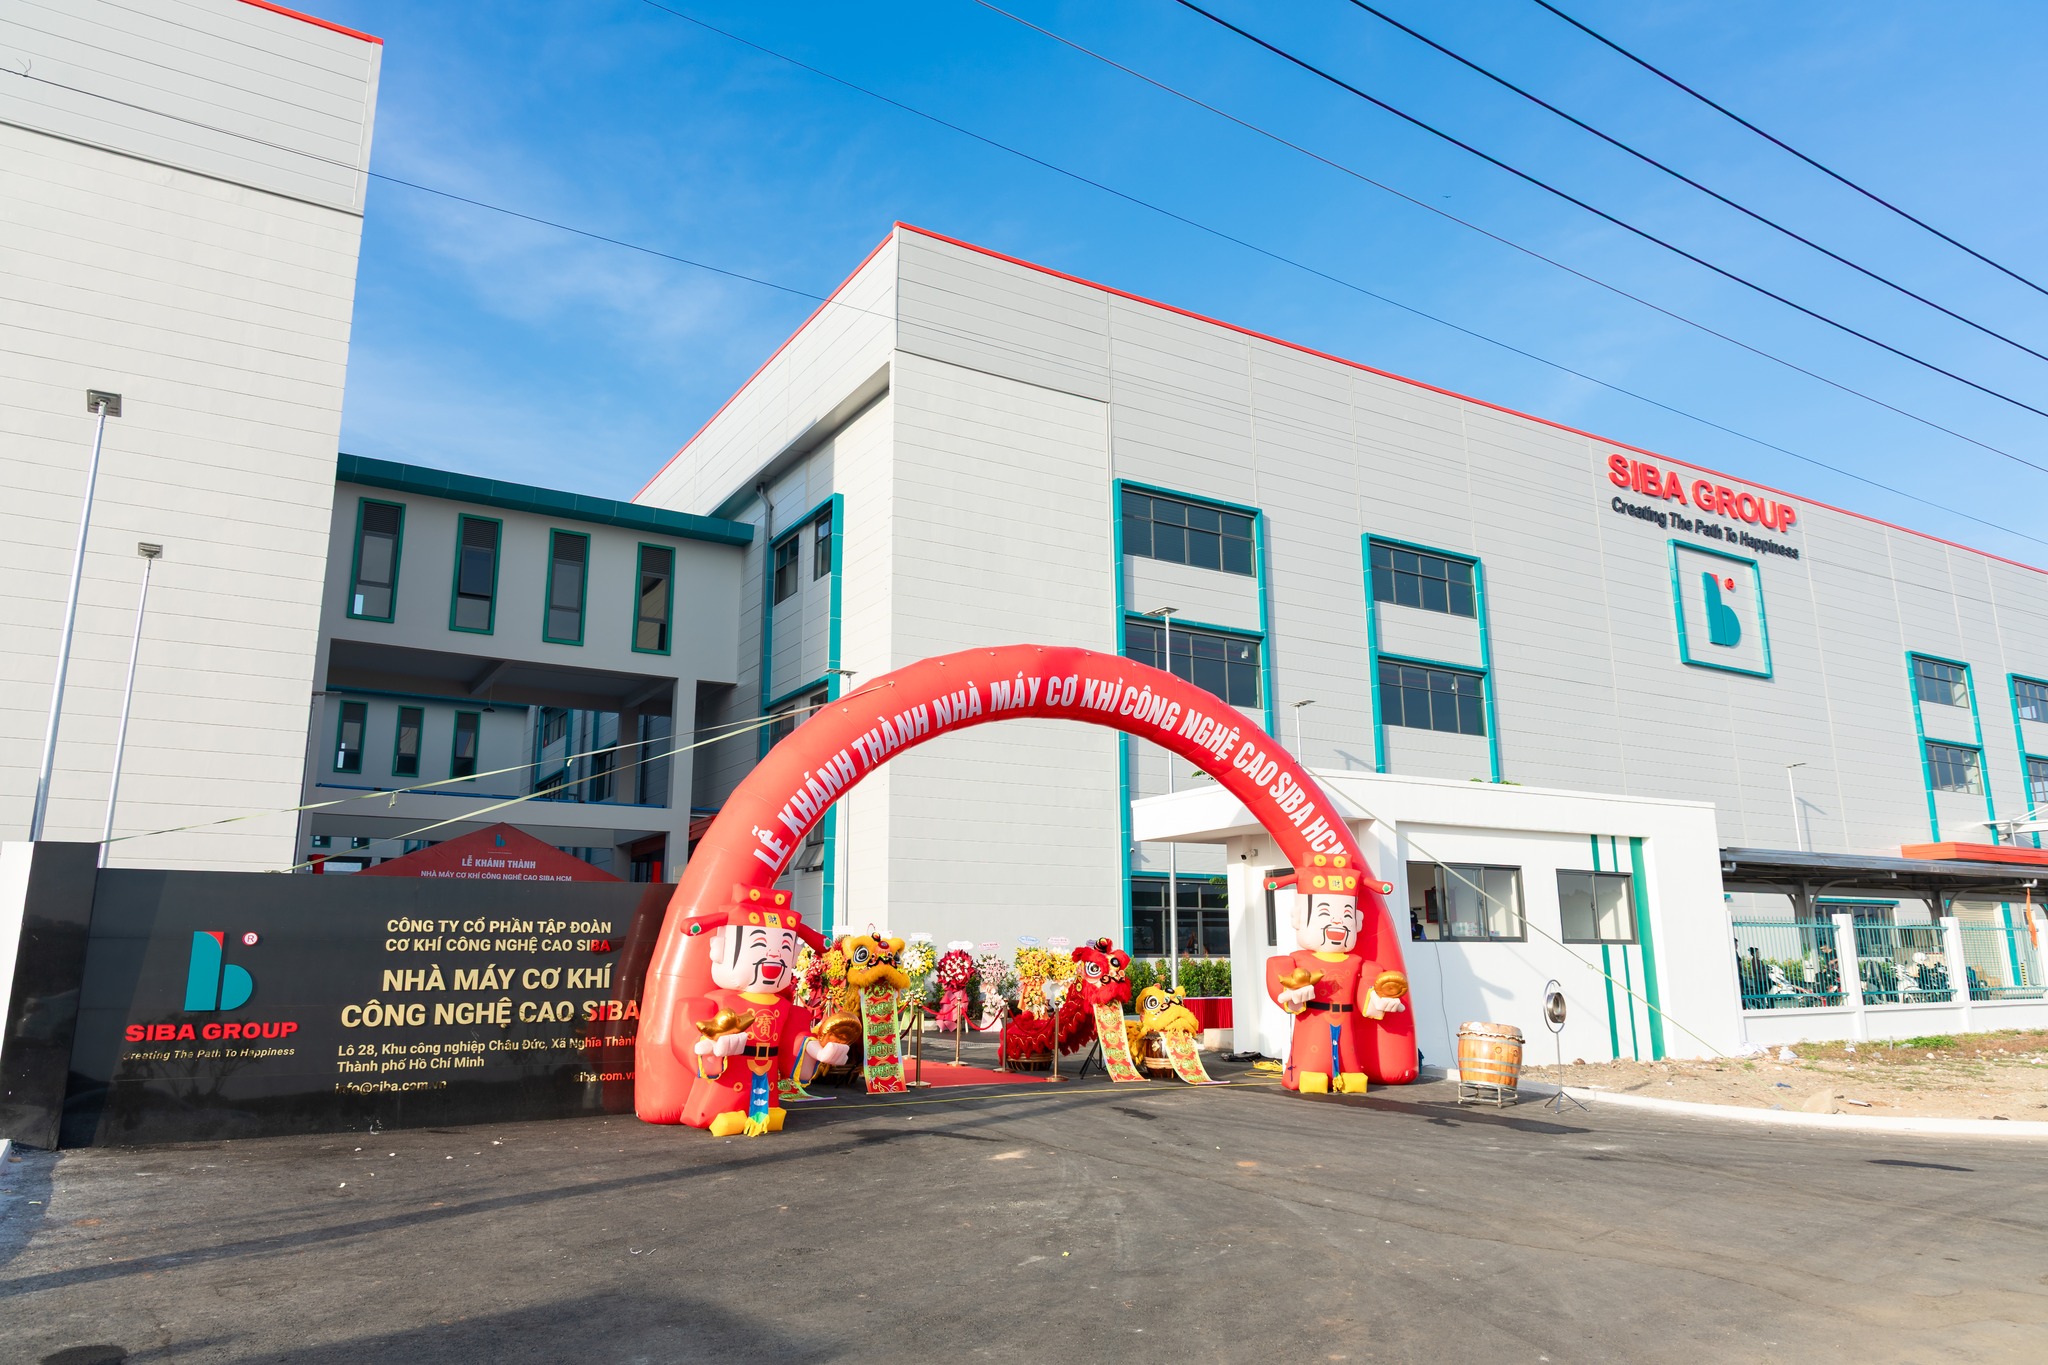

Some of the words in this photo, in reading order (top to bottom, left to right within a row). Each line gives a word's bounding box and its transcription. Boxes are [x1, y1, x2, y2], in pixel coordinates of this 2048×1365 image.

[1608, 454, 1687, 505] SIBA
[1692, 479, 1796, 533] GROUP
[1612, 496, 1667, 528] Creating
[1669, 511, 1693, 531] The
[1695, 519, 1723, 540] Path
[1724, 526, 1738, 543] To
[1740, 531, 1799, 559] Happiness
[751, 825, 791, 872] LỄ
[777, 748, 858, 838] KHÁNH
[851, 704, 930, 768] THÀNH
[932, 680, 983, 728] NHÀ
[990, 670, 1042, 713] MÁY
[1046, 674, 1079, 706] CƠ
[1119, 684, 1181, 731] CÔNG
[1177, 708, 1241, 762] NGHỆ
[1232, 741, 1278, 787] CAO
[1268, 771, 1315, 828] SIBA
[475, 858, 505, 869] KHÁNH
[507, 859, 536, 869] THÀNH
[387, 917, 434, 933] CÔNG
[438, 920, 459, 933] TY
[463, 916, 486, 933] CỔ
[489, 916, 533, 933] PHẦN
[537, 918, 567, 936] TẬP
[570, 918, 612, 934] ĐOÀN
[385, 938, 410, 952] CƠ
[413, 935, 443, 951] KHÍ
[446, 936, 490, 952] CÔNG
[495, 936, 538, 954] NGHỆ
[541, 939, 572, 951] CAO
[576, 939, 611, 952] SIBA
[382, 963, 446, 992] NHÀ
[453, 963, 516, 991] MÁY
[522, 967, 562, 990] CƠ
[567, 962, 613, 989] KHÍ
[341, 998, 426, 1028] CÔNG
[434, 996, 513, 1029] NGHỆ
[518, 1000, 575, 1023] CAO
[581, 1000, 640, 1022] SIBA
[124, 1023, 197, 1042] SIBA
[202, 1021, 298, 1040] GROUP
[174, 1050, 194, 1059] The
[196, 1049, 222, 1059] Path
[225, 1048, 237, 1057] To
[240, 1047, 296, 1059] Happiness
[338, 1044, 355, 1057] Lô
[358, 1043, 378, 1057] 28,
[381, 1043, 407, 1055] Khu
[409, 1042, 441, 1055] công
[444, 1040, 486, 1055] nghiệp
[488, 1039, 519, 1051] Châu
[550, 1037, 566, 1049] Xã
[337, 1060, 378, 1073] Thành
[381, 1058, 407, 1073] phố
[409, 1058, 427, 1070] Hồ
[430, 1057, 451, 1069] Chí
[454, 1056, 485, 1068] Minh
